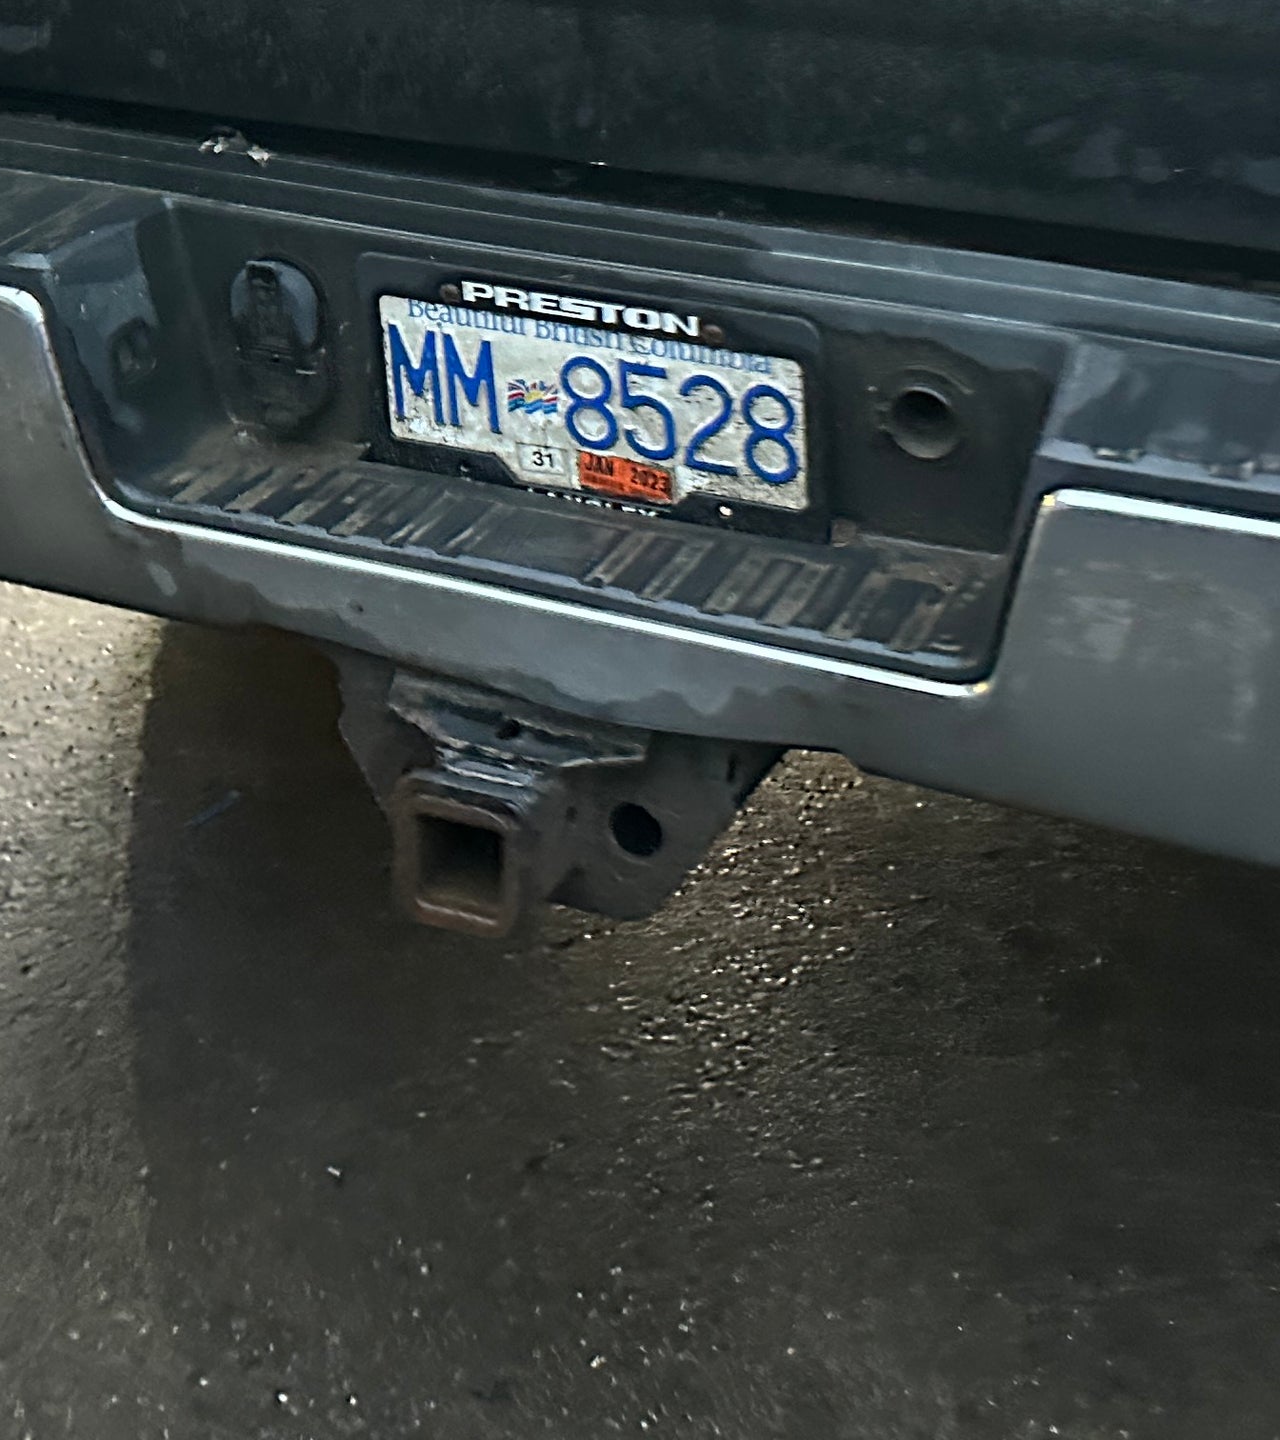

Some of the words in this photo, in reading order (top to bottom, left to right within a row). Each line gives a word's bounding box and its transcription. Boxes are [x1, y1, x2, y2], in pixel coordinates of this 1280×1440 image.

[461, 280, 700, 339] PRESTON
[388, 323, 502, 435] MM
[559, 355, 800, 485] 8528
[532, 450, 554, 469] 31
